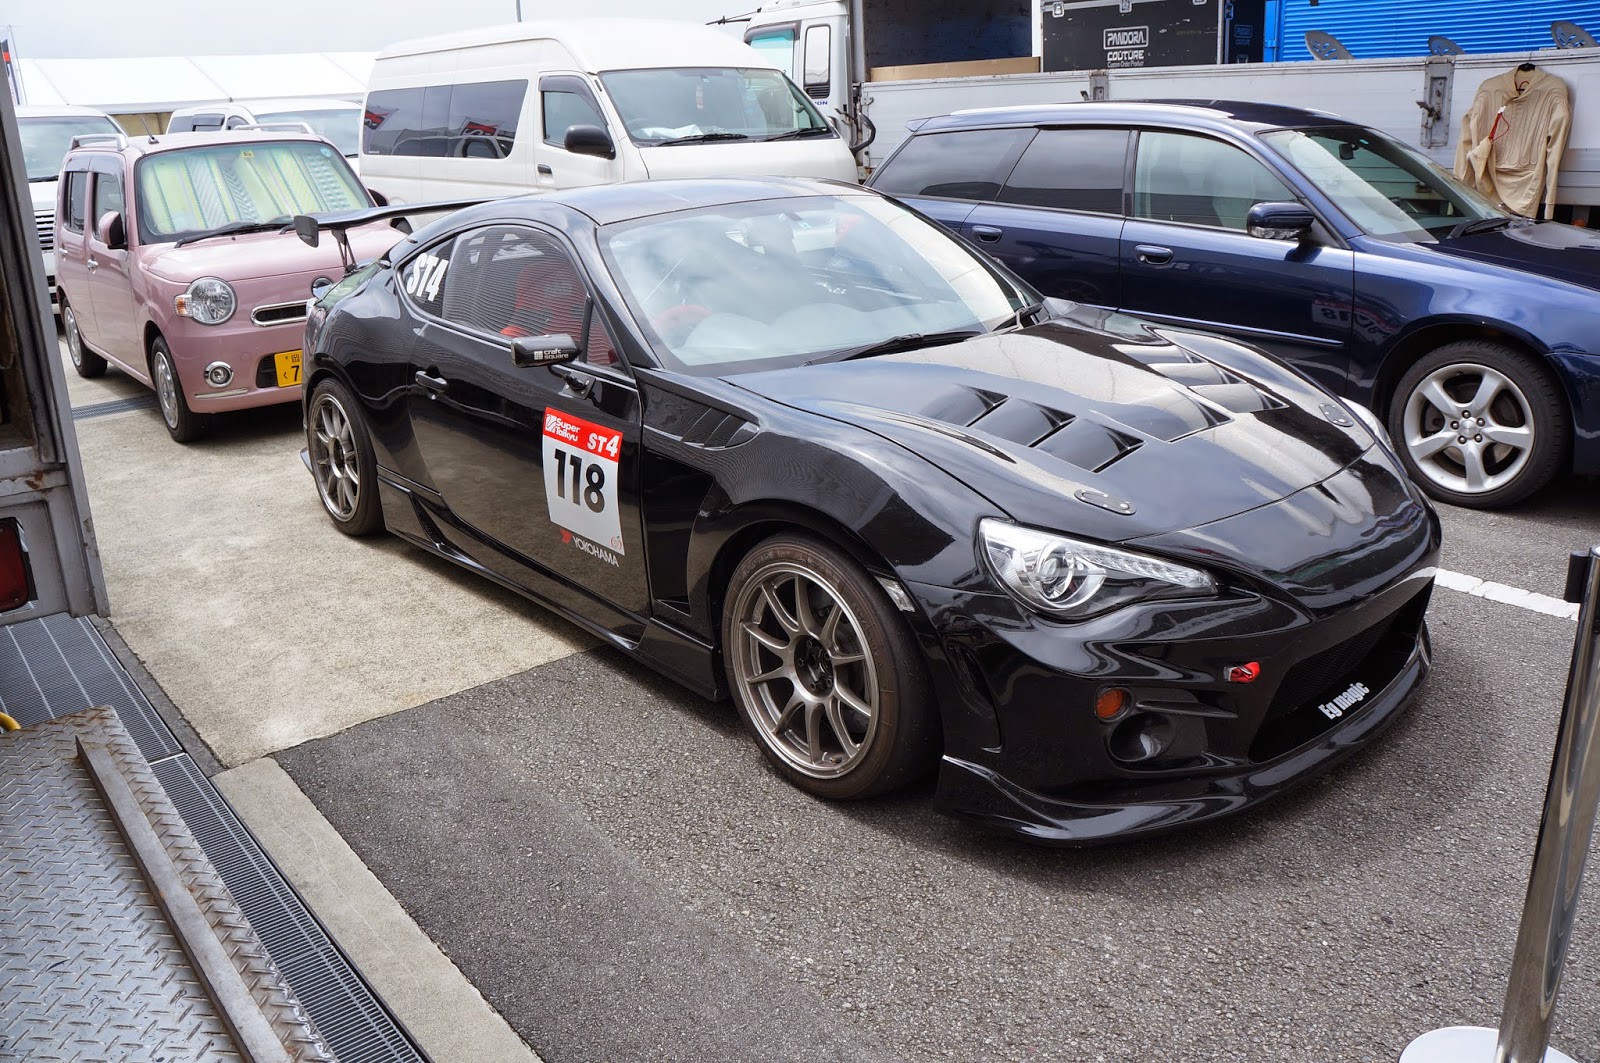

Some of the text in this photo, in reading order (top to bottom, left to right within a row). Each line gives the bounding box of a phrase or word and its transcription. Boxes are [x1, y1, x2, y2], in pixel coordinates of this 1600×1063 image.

[1107, 31, 1145, 46] PANDORA
[1107, 50, 1144, 61] COUTURE
[406, 252, 449, 302] ST4
[291, 364, 300, 382] 7
[555, 426, 578, 442] Taikyu
[556, 417, 581, 433] Super
[587, 432, 620, 458] ST4
[554, 448, 605, 514] 118
[572, 535, 620, 568] YOKOHAMA
[1317, 682, 1370, 720] Eg magic
